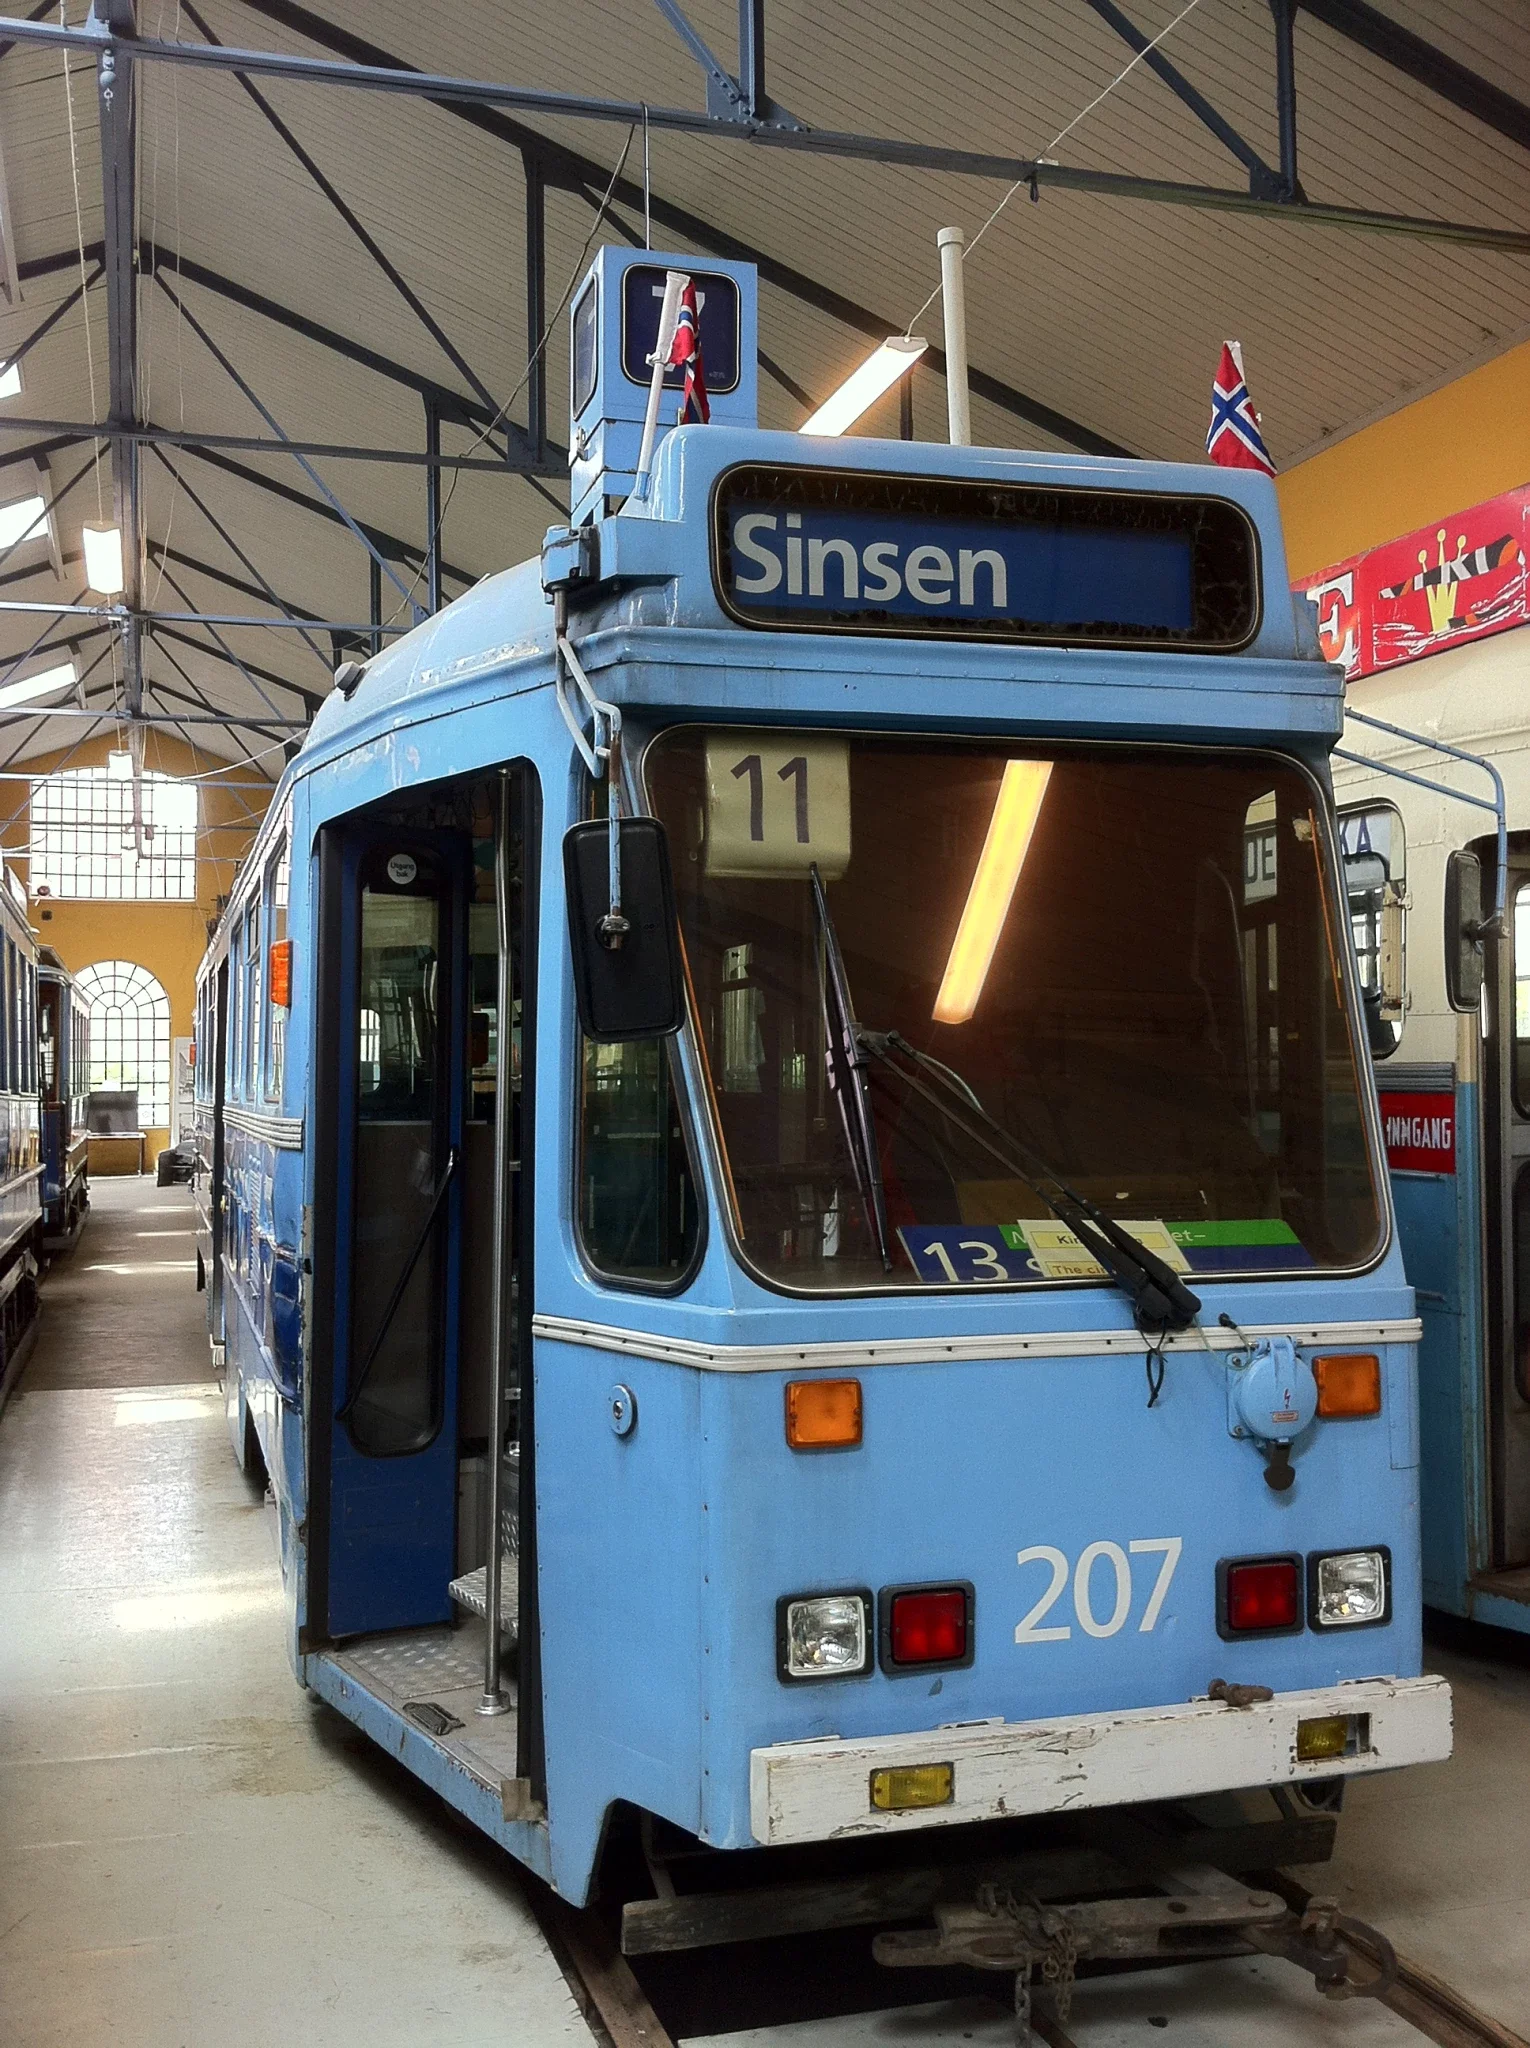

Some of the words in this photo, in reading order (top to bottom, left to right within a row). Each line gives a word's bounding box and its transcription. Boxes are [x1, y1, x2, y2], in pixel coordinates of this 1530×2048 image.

[733, 512, 1008, 608] Sinsen
[730, 754, 810, 844] 11
[1386, 1116, 1451, 1149] INNGANG
[923, 1241, 1008, 1282] 13
[1053, 1264, 1081, 1275] The
[1014, 1536, 1183, 1644] 207
